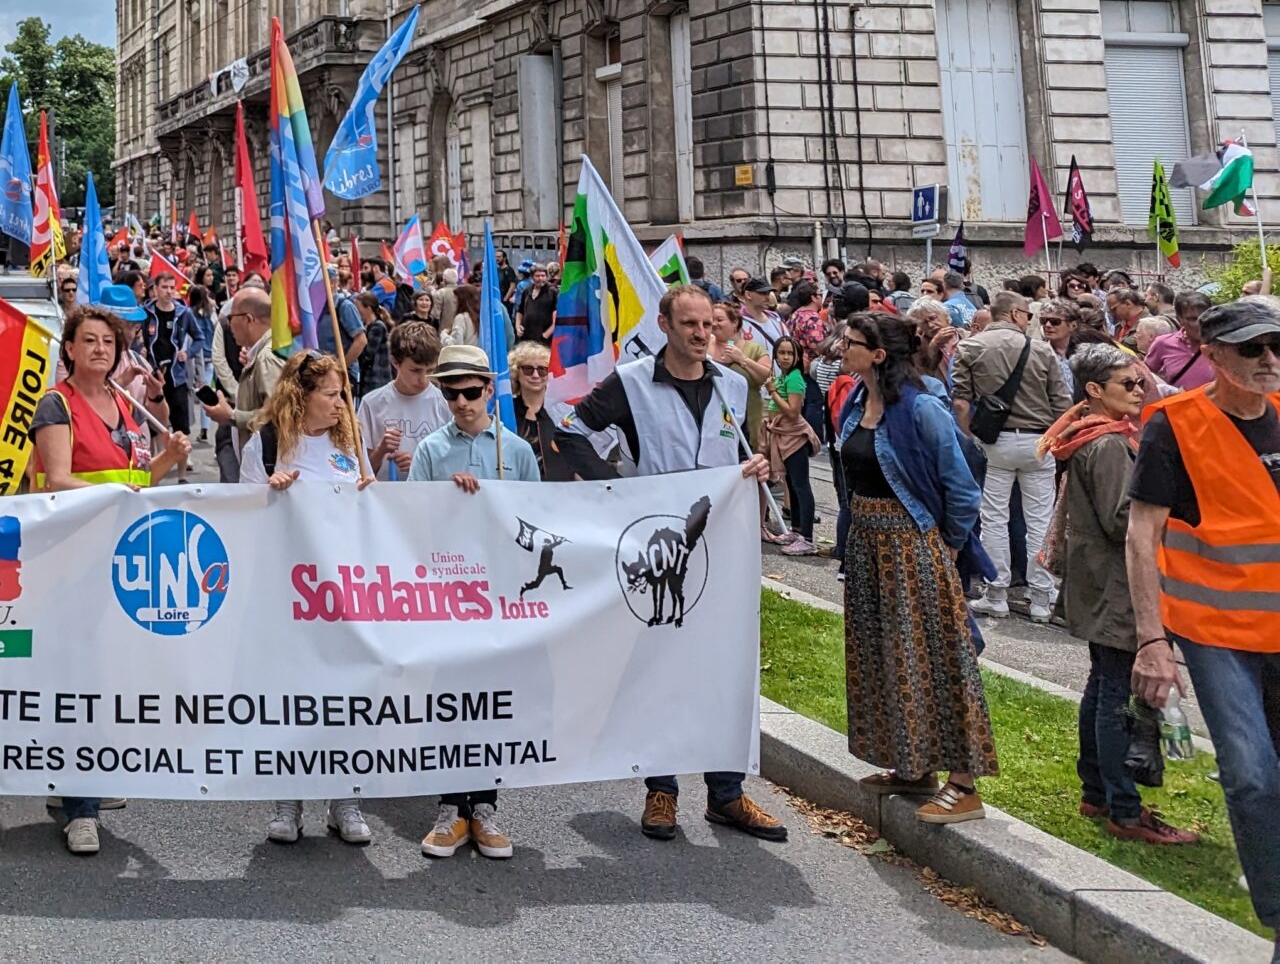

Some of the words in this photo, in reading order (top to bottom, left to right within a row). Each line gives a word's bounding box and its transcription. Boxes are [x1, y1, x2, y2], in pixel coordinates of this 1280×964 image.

[431, 552, 465, 564] Union
[432, 564, 487, 579] syndicale
[648, 538, 689, 577] CNT
[291, 564, 493, 622] Solidaires
[498, 596, 550, 620] loire
[157, 609, 190, 621] Loire
[54, 693, 102, 724] ET
[114, 694, 161, 724] LE
[175, 690, 514, 727] NEOLIBERALISME
[76, 746, 194, 774] SOCIAL
[205, 749, 244, 775] ET
[255, 739, 557, 776] ENVIRONNEMENTAL
